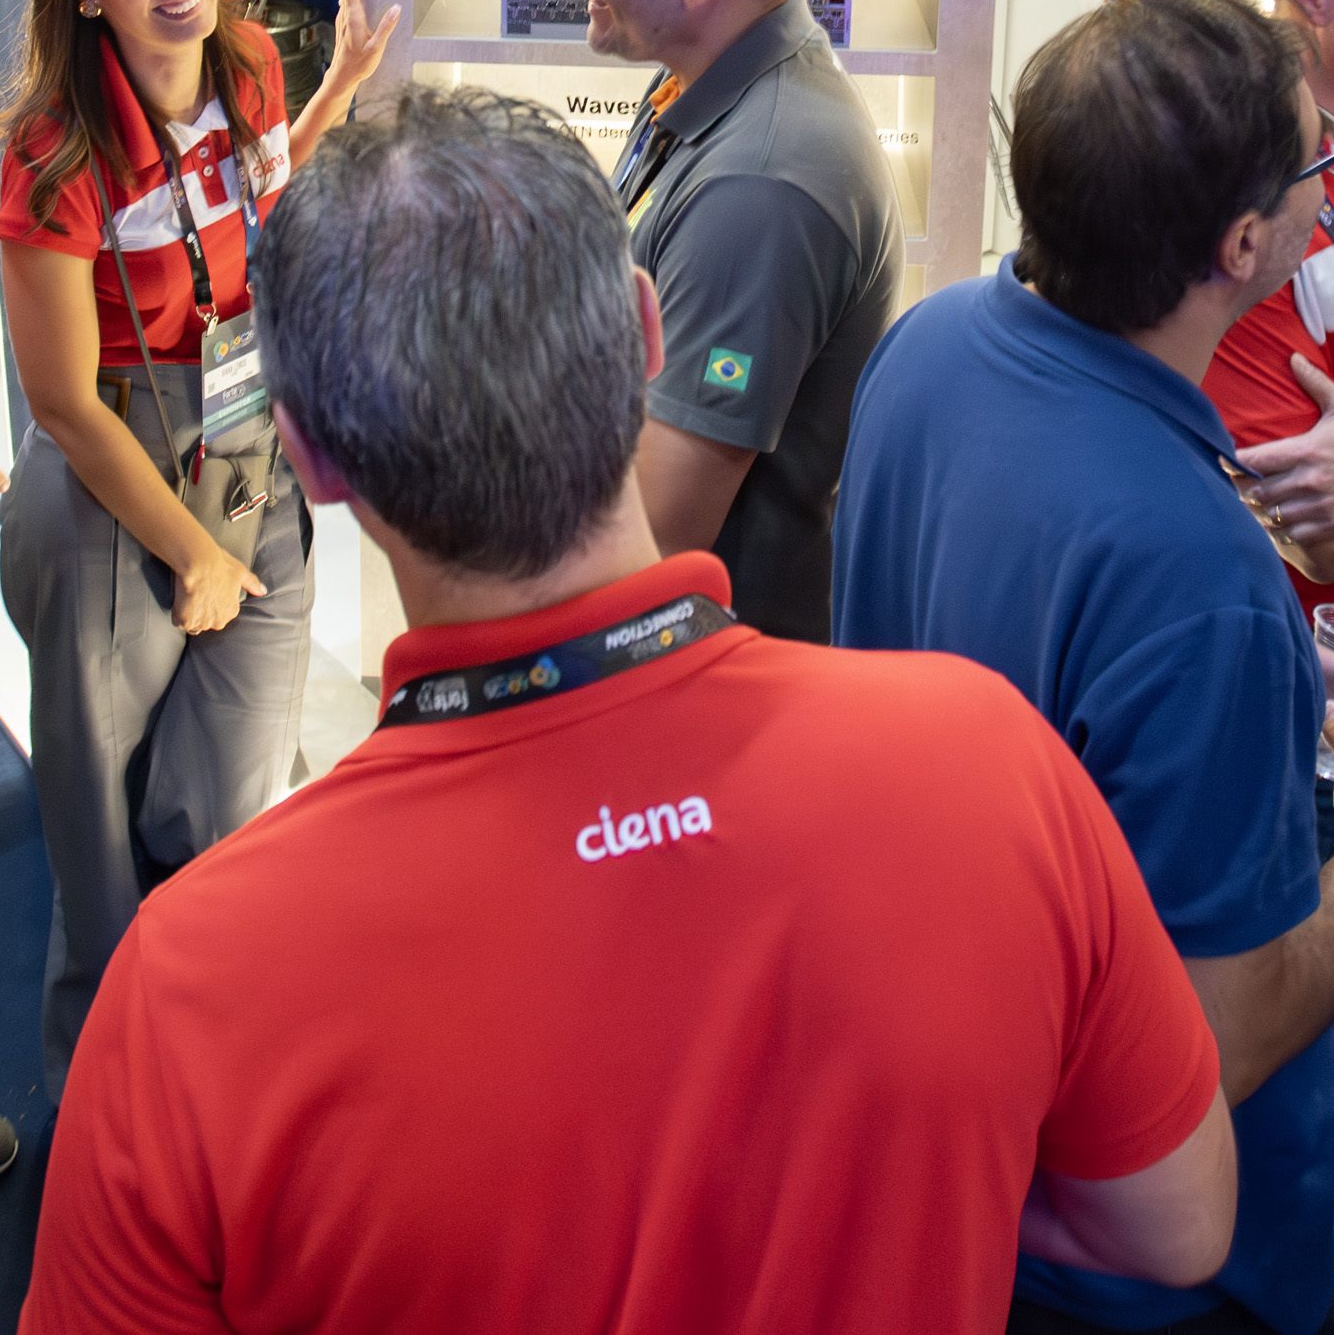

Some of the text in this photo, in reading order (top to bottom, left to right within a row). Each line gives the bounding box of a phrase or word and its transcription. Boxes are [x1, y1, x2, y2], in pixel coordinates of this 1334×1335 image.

[567, 96, 641, 115] Waves
[605, 600, 694, 651] CONNECTION
[575, 795, 714, 864] ciena
